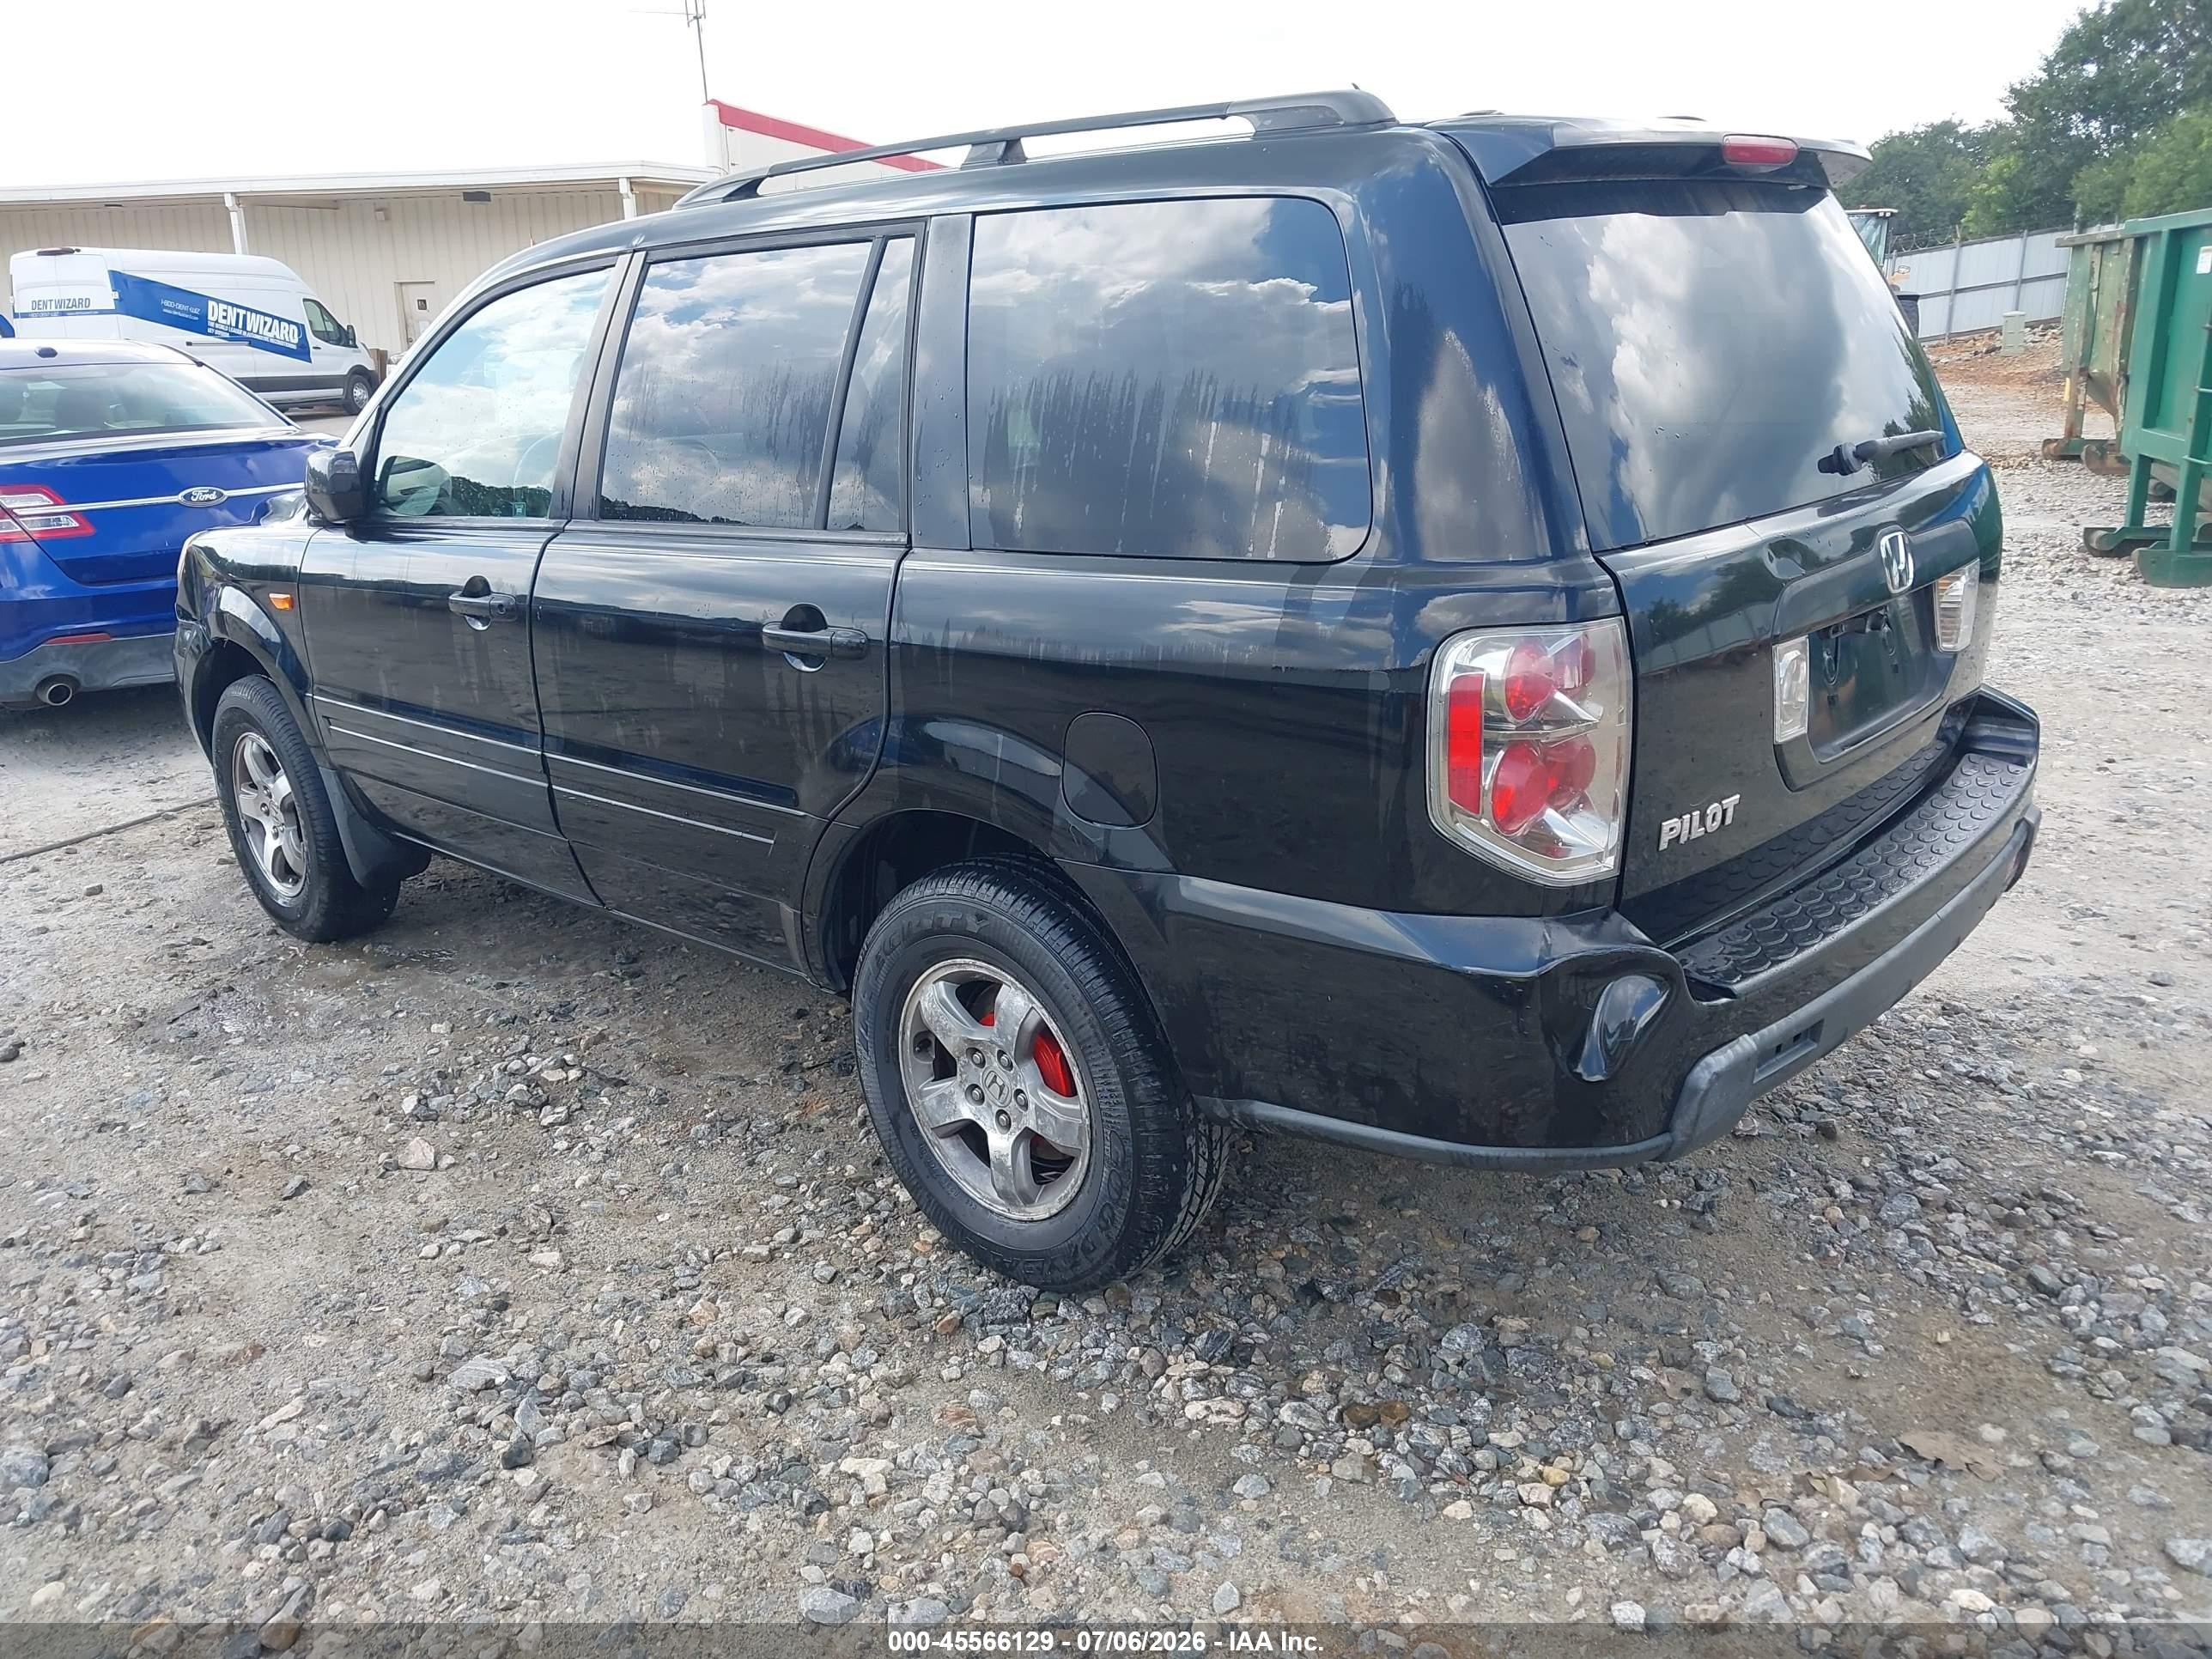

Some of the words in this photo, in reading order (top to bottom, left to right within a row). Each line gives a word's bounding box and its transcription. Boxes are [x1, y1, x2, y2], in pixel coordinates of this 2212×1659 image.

[31, 299, 54, 310] DENT
[54, 298, 91, 310] WIZARD
[208, 300, 246, 329] DENT
[246, 311, 299, 343] WIZARD
[191, 489, 217, 501] Ford
[1658, 793, 1741, 851] PILOT
